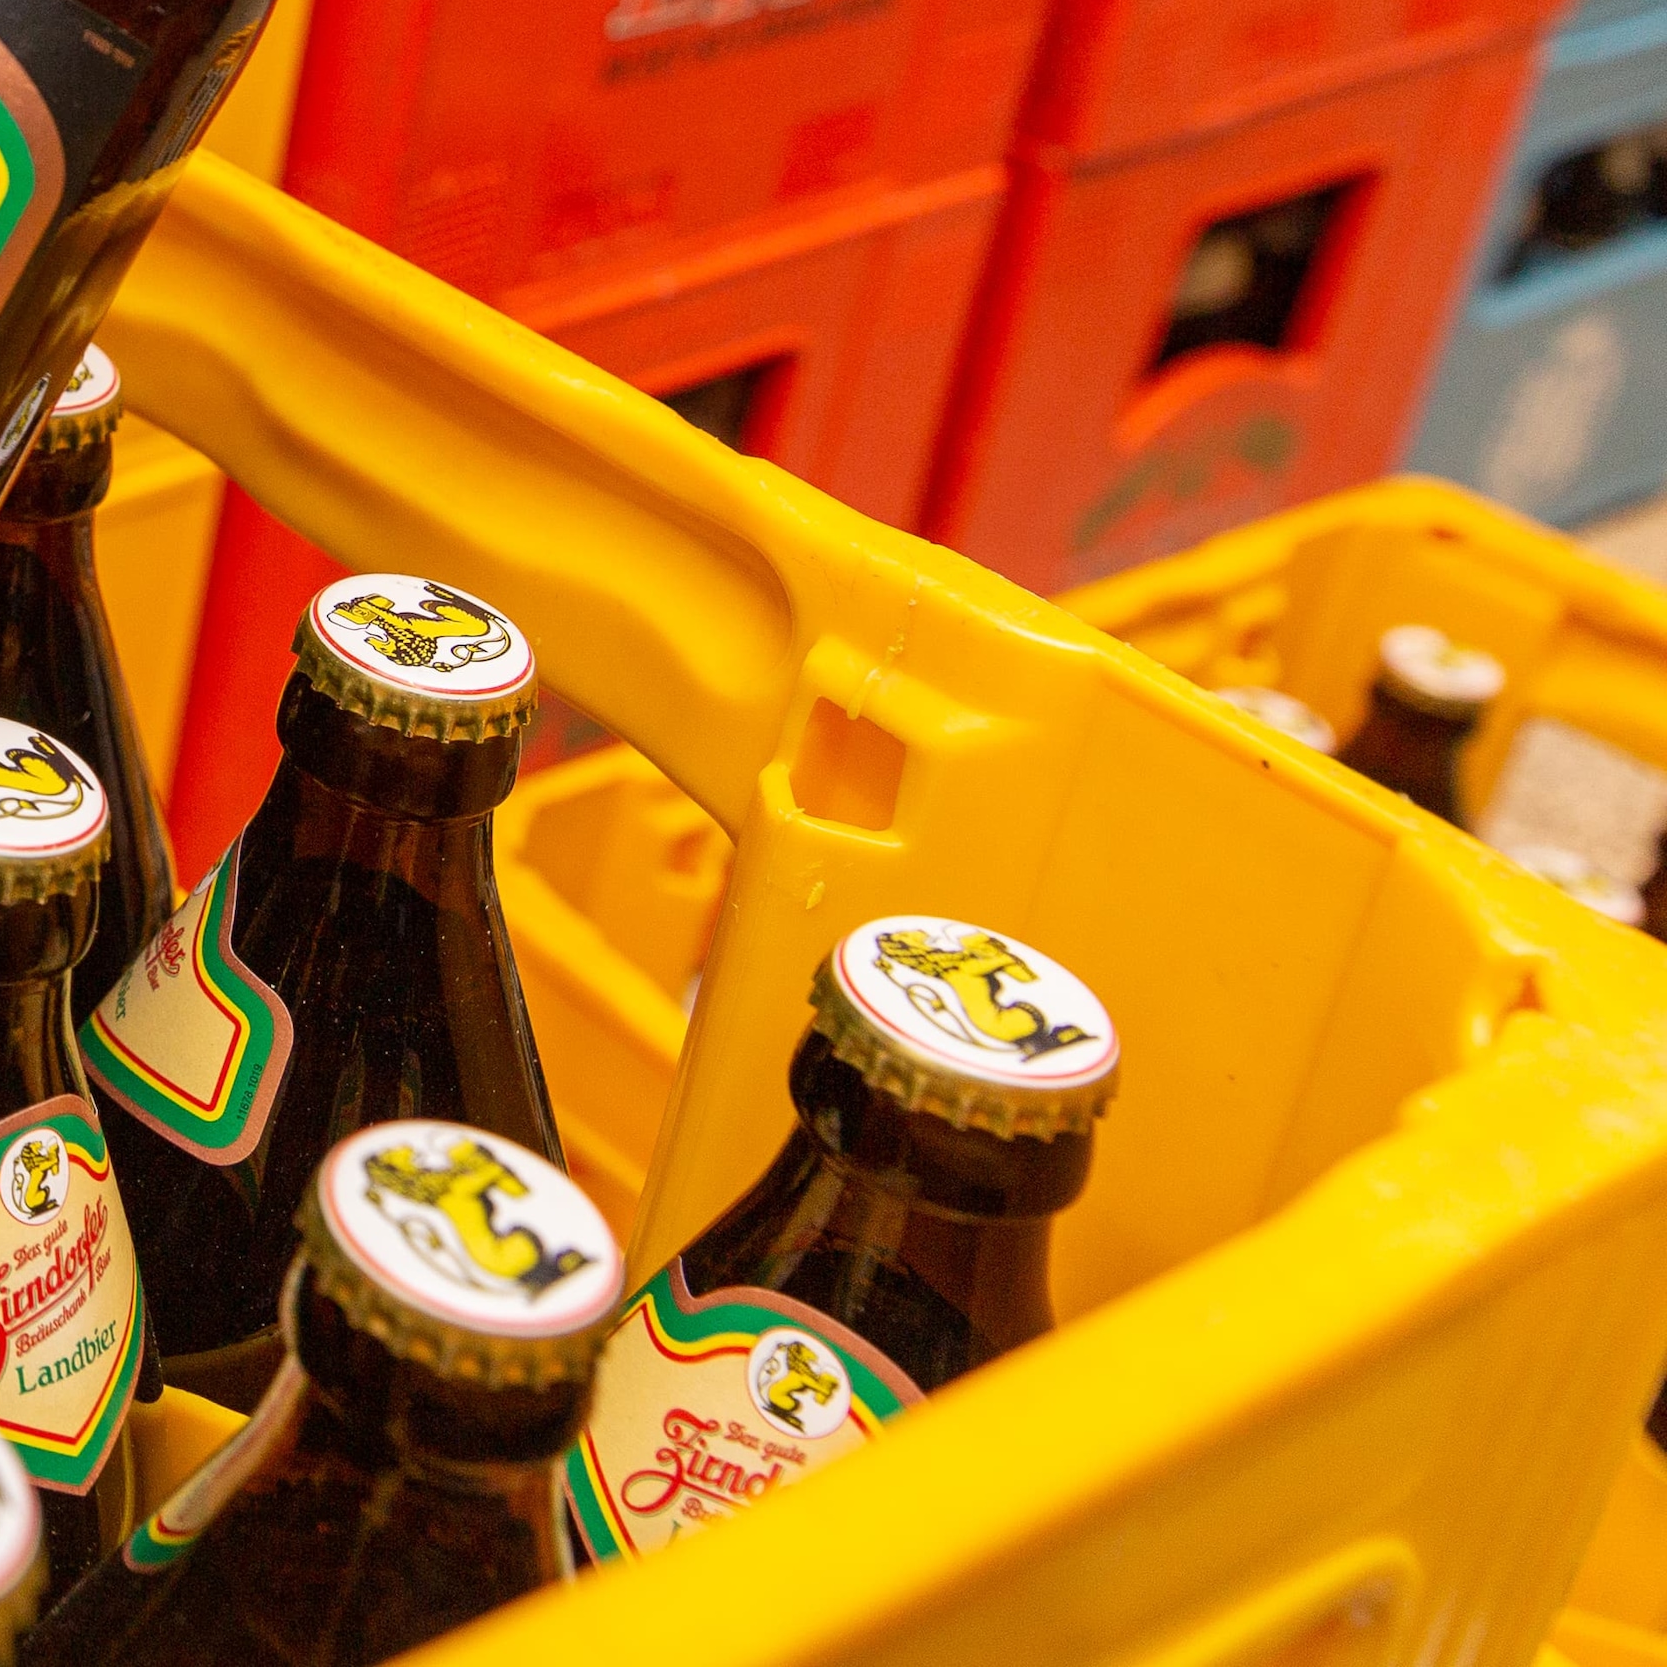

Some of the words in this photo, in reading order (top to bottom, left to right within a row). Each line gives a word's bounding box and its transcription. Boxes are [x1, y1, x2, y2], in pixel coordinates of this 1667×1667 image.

[13, 1243, 42, 1270] Das
[43, 1219, 69, 1257] gute
[14, 1319, 117, 1396] Landbier
[15, 1290, 88, 1358] Bräuschank
[621, 1408, 783, 1516] Zirnd
